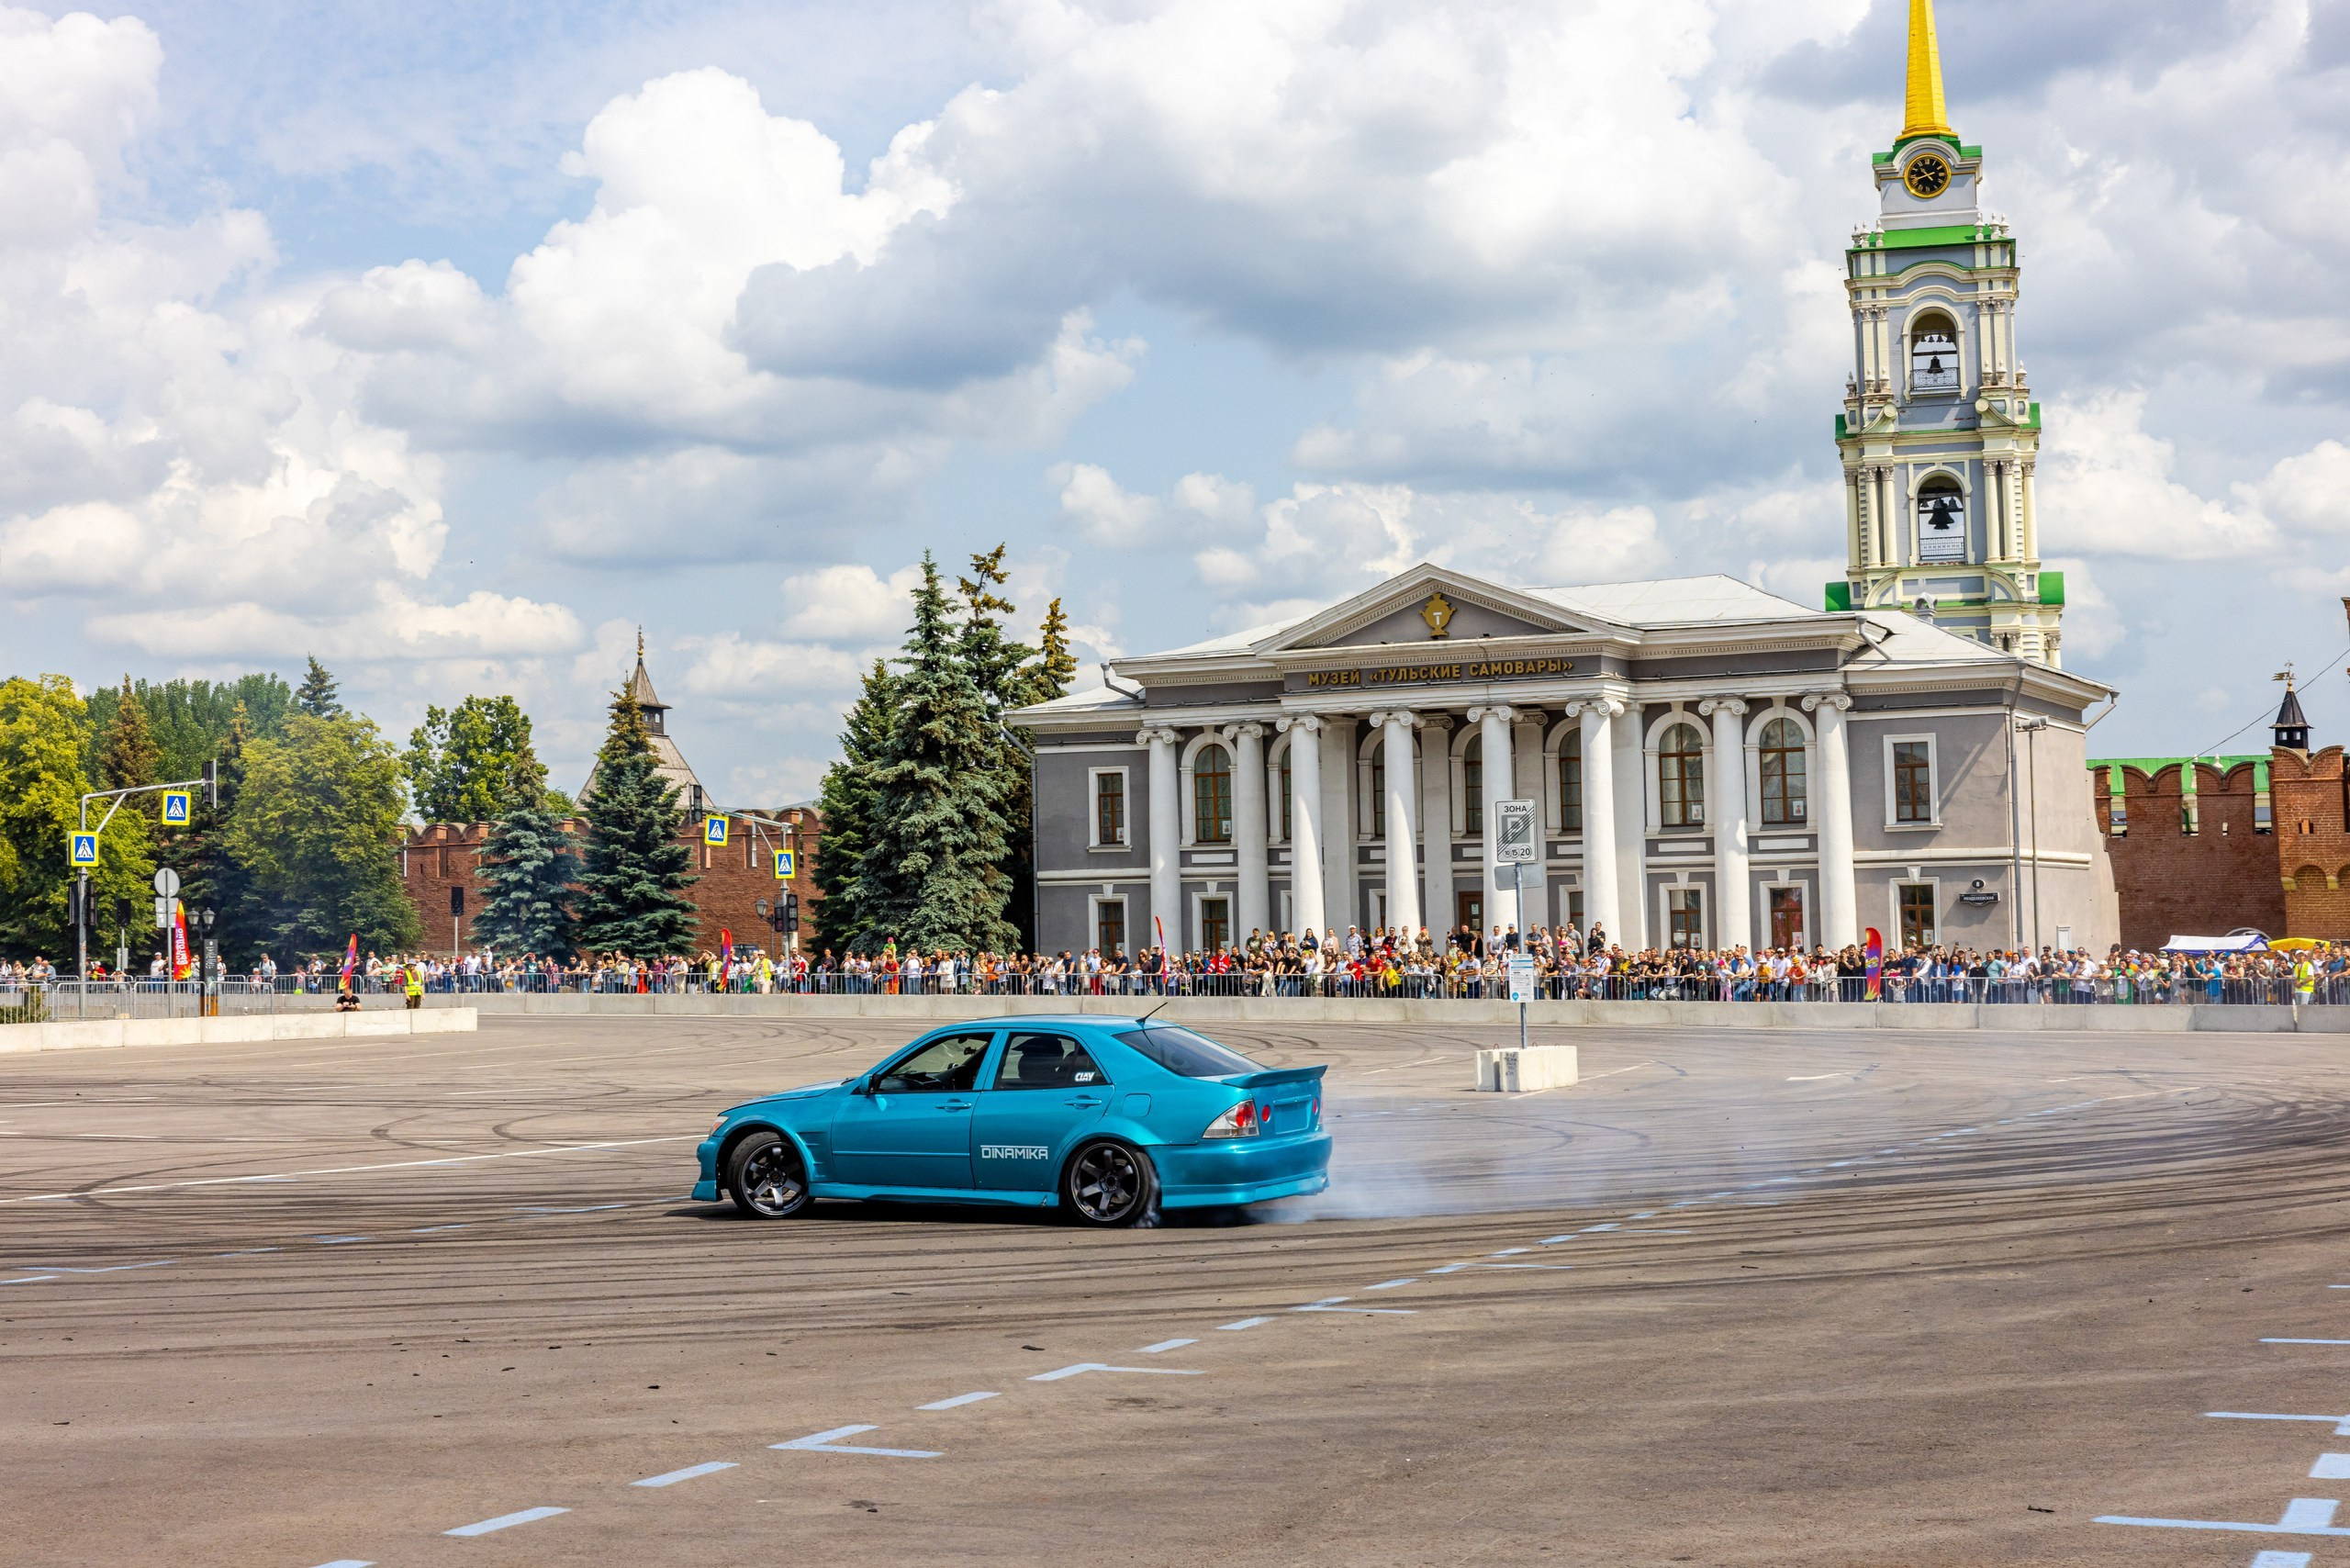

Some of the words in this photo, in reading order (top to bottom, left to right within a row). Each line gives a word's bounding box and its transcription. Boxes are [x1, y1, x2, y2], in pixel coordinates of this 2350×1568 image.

[1308, 667, 1360, 686] МУЗЕЙ
[1369, 665, 1461, 682] «ТУЛЬСКИЕ
[1469, 659, 1575, 677] САМОВАРЫ»
[1504, 805, 1528, 813] ЗОНА
[981, 1148, 1048, 1159] DINAMIKA
